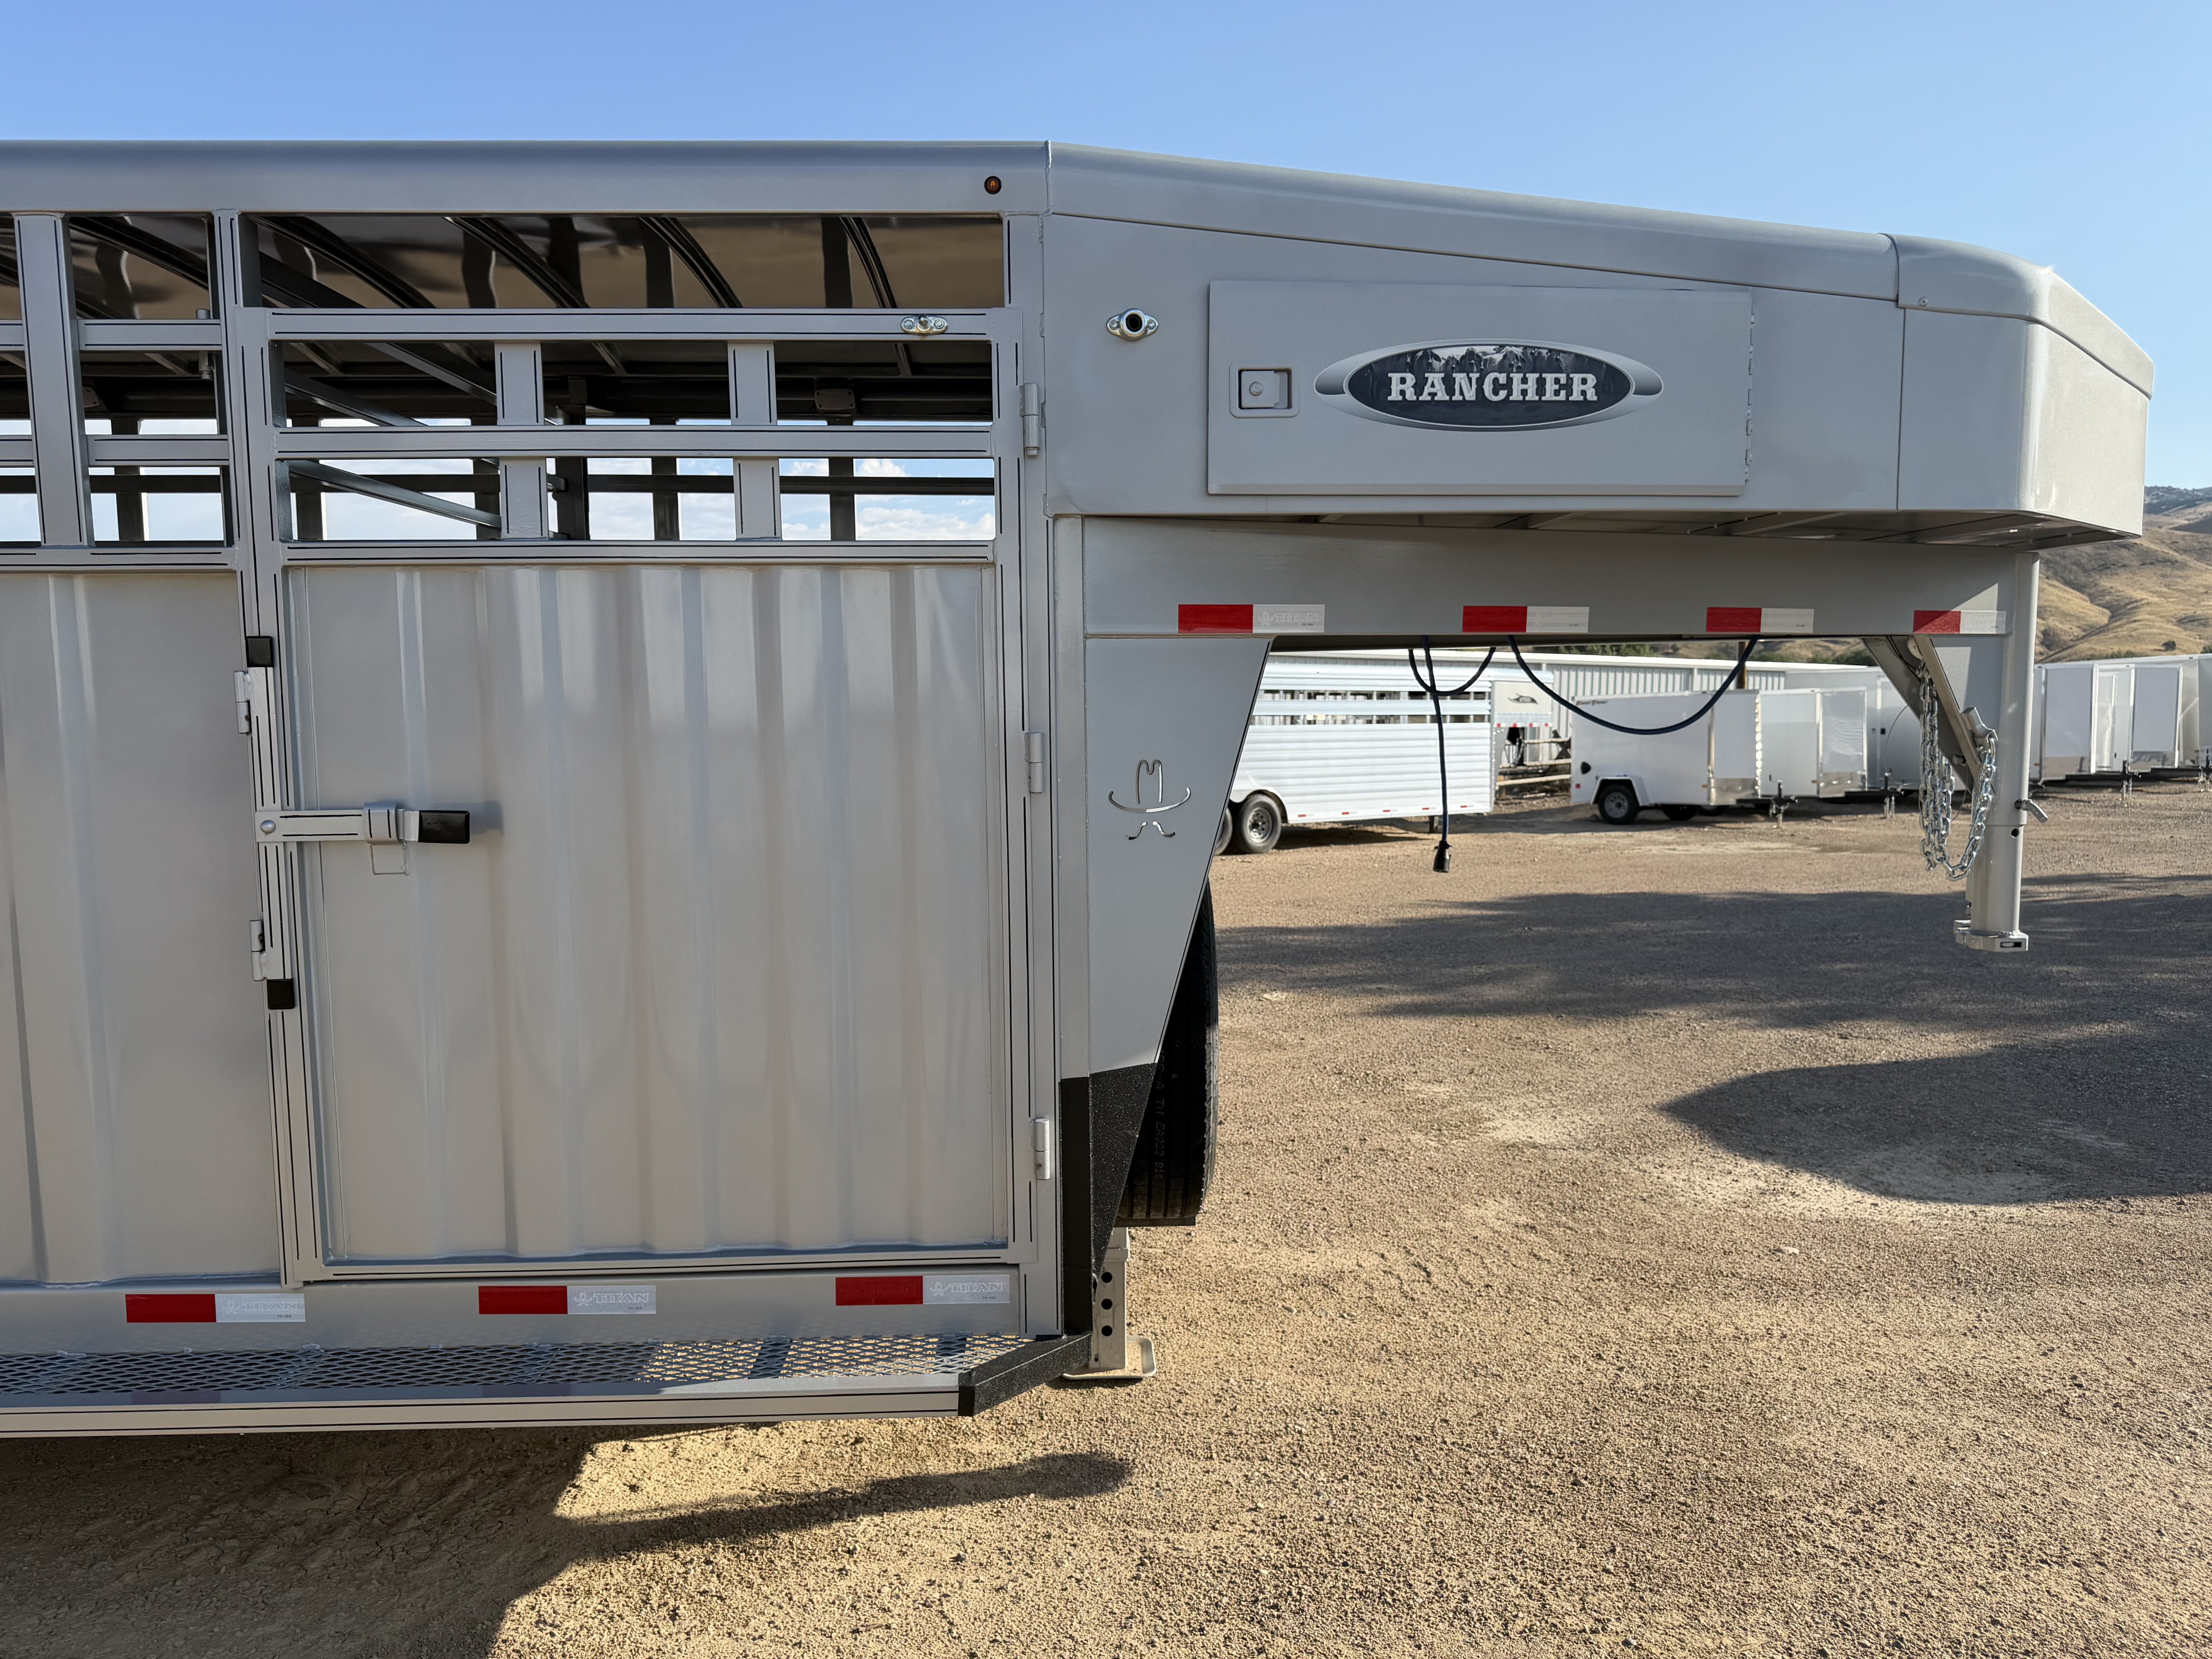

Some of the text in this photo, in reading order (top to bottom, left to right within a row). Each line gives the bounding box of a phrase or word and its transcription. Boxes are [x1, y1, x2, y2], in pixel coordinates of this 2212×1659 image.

[1387, 372, 1598, 401] RANCHER
[1274, 612, 1319, 623] TITAN
[948, 1281, 1003, 1293] TITAN
[593, 1292, 650, 1303] TITAN
[242, 1301, 298, 1312] TITAN
